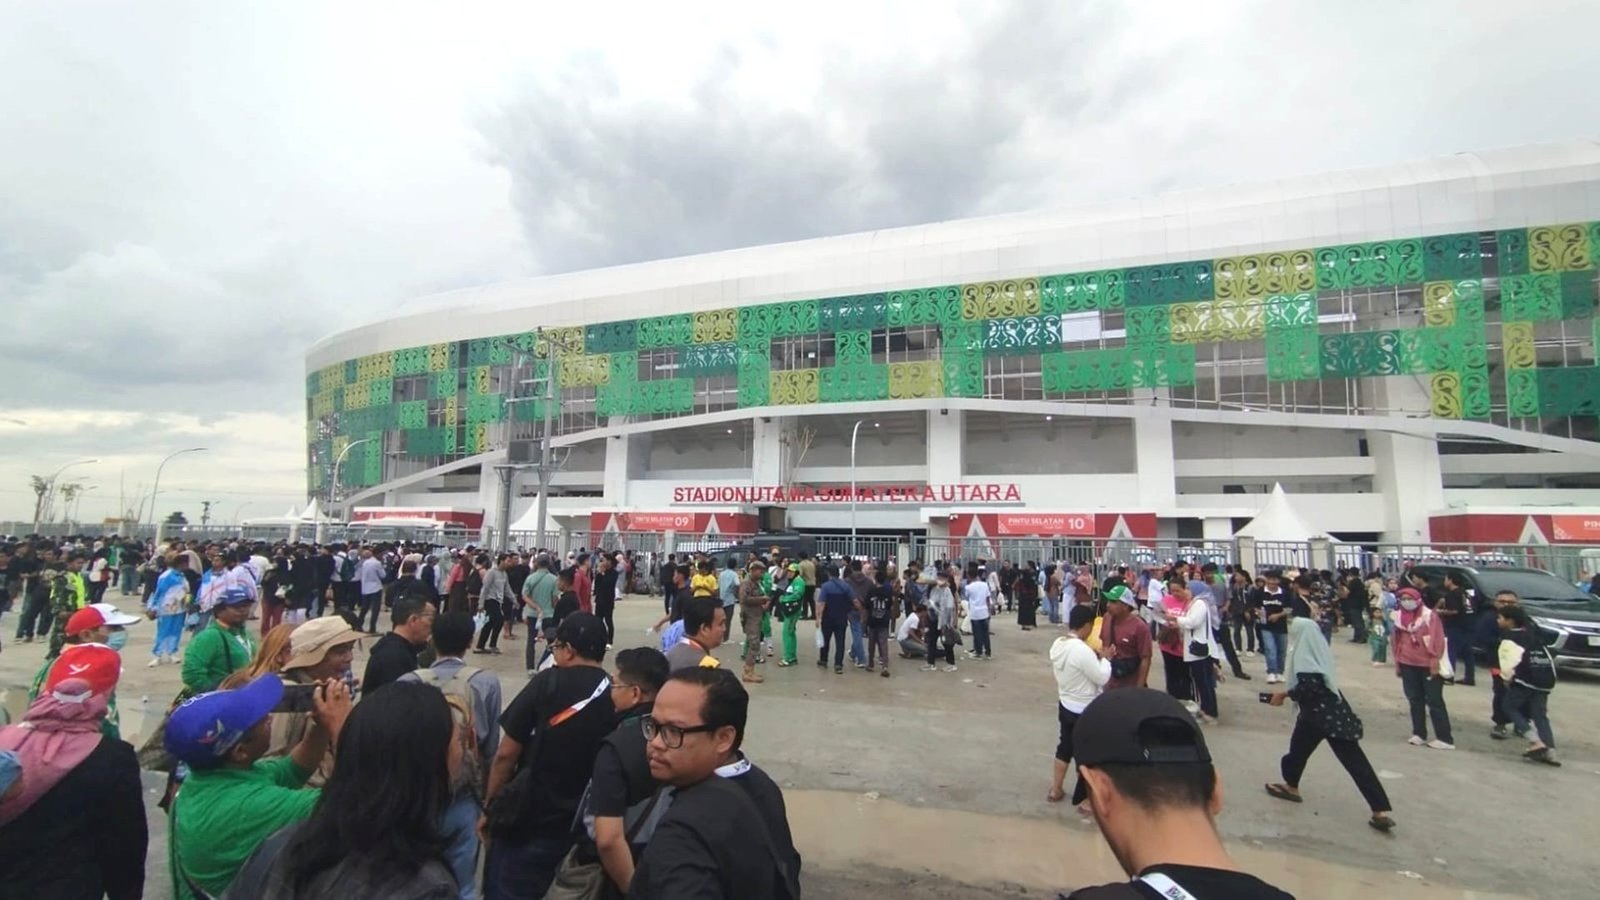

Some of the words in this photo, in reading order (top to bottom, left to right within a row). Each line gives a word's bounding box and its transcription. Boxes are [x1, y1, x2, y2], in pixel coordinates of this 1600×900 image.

[674, 487, 746, 502] STADION
[751, 486, 815, 502] UTAMA
[819, 485, 935, 502] SUMATERA
[941, 484, 1021, 500] UTARA
[674, 516, 689, 527] 09
[1008, 517, 1030, 525] PINTU
[1031, 517, 1064, 525] SELATAN
[1068, 517, 1085, 530] 10
